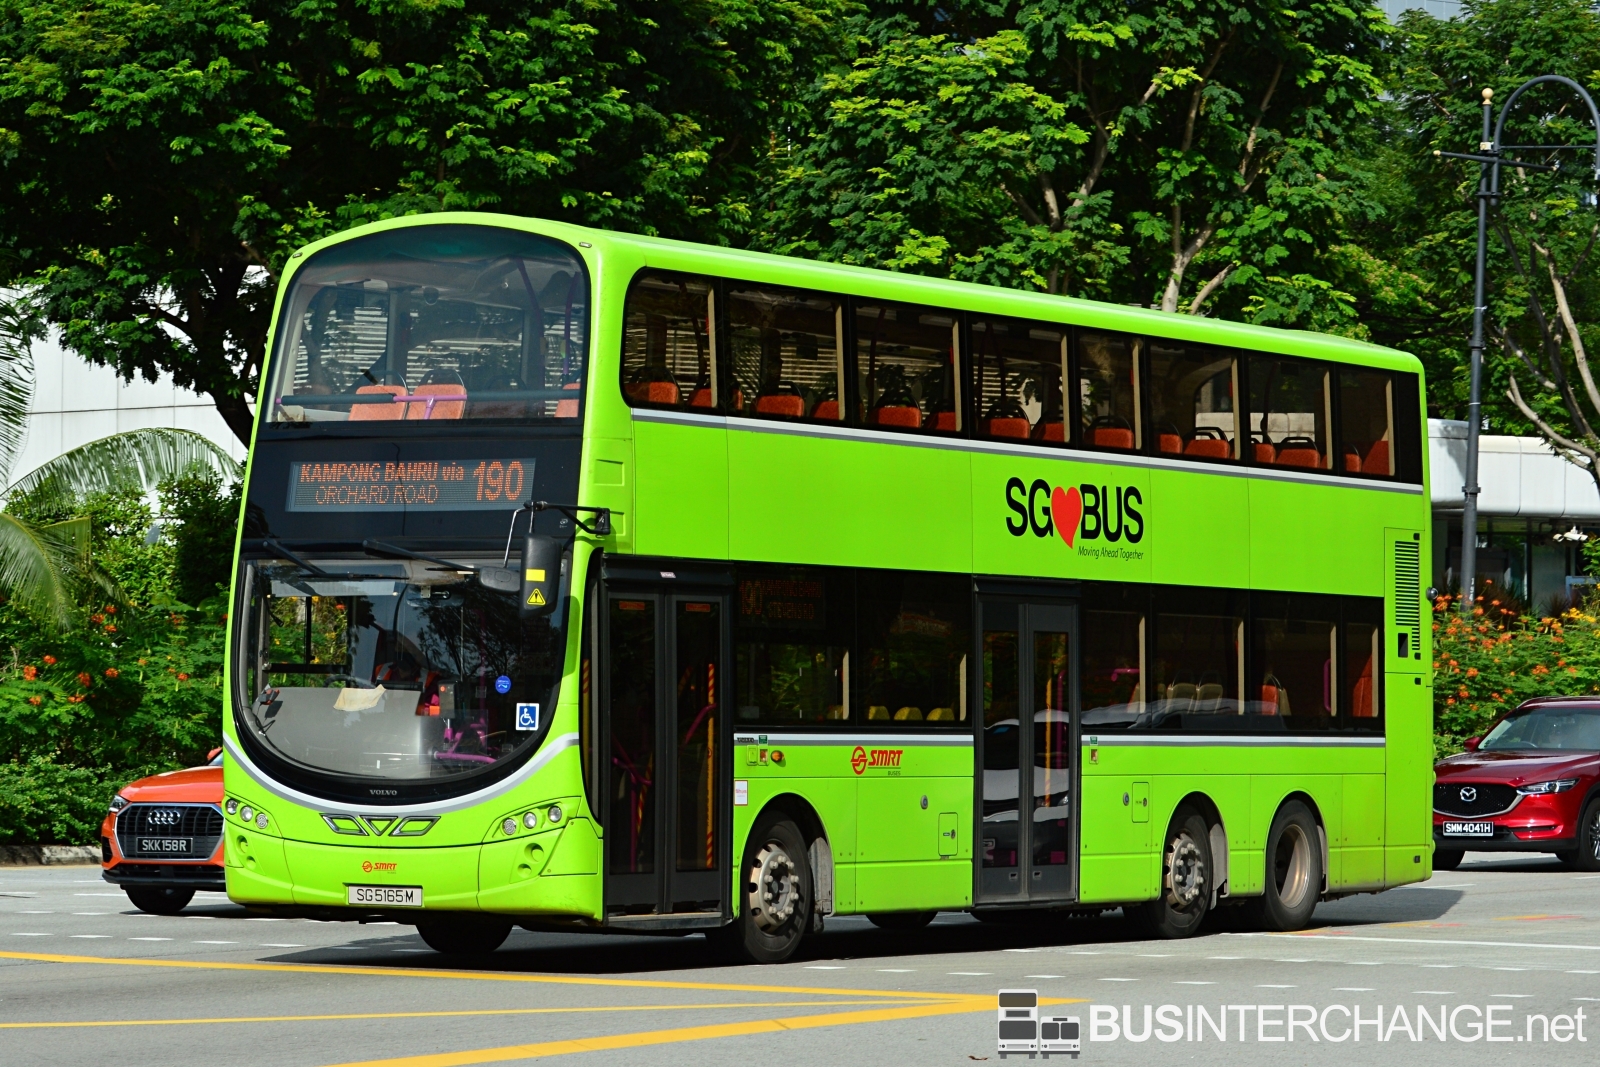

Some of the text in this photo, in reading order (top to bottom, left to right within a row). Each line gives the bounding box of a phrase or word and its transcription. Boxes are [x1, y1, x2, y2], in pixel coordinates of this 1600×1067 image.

[301, 462, 464, 482] KAMPONG BAHRU via
[473, 461, 524, 501] 190
[316, 484, 439, 504] ORCHARD ROAD
[1078, 546, 1144, 561] Moving Ahead Together
[868, 750, 903, 766] SMRT
[142, 839, 187, 852] SKK158R
[356, 888, 414, 903] SG5165M
